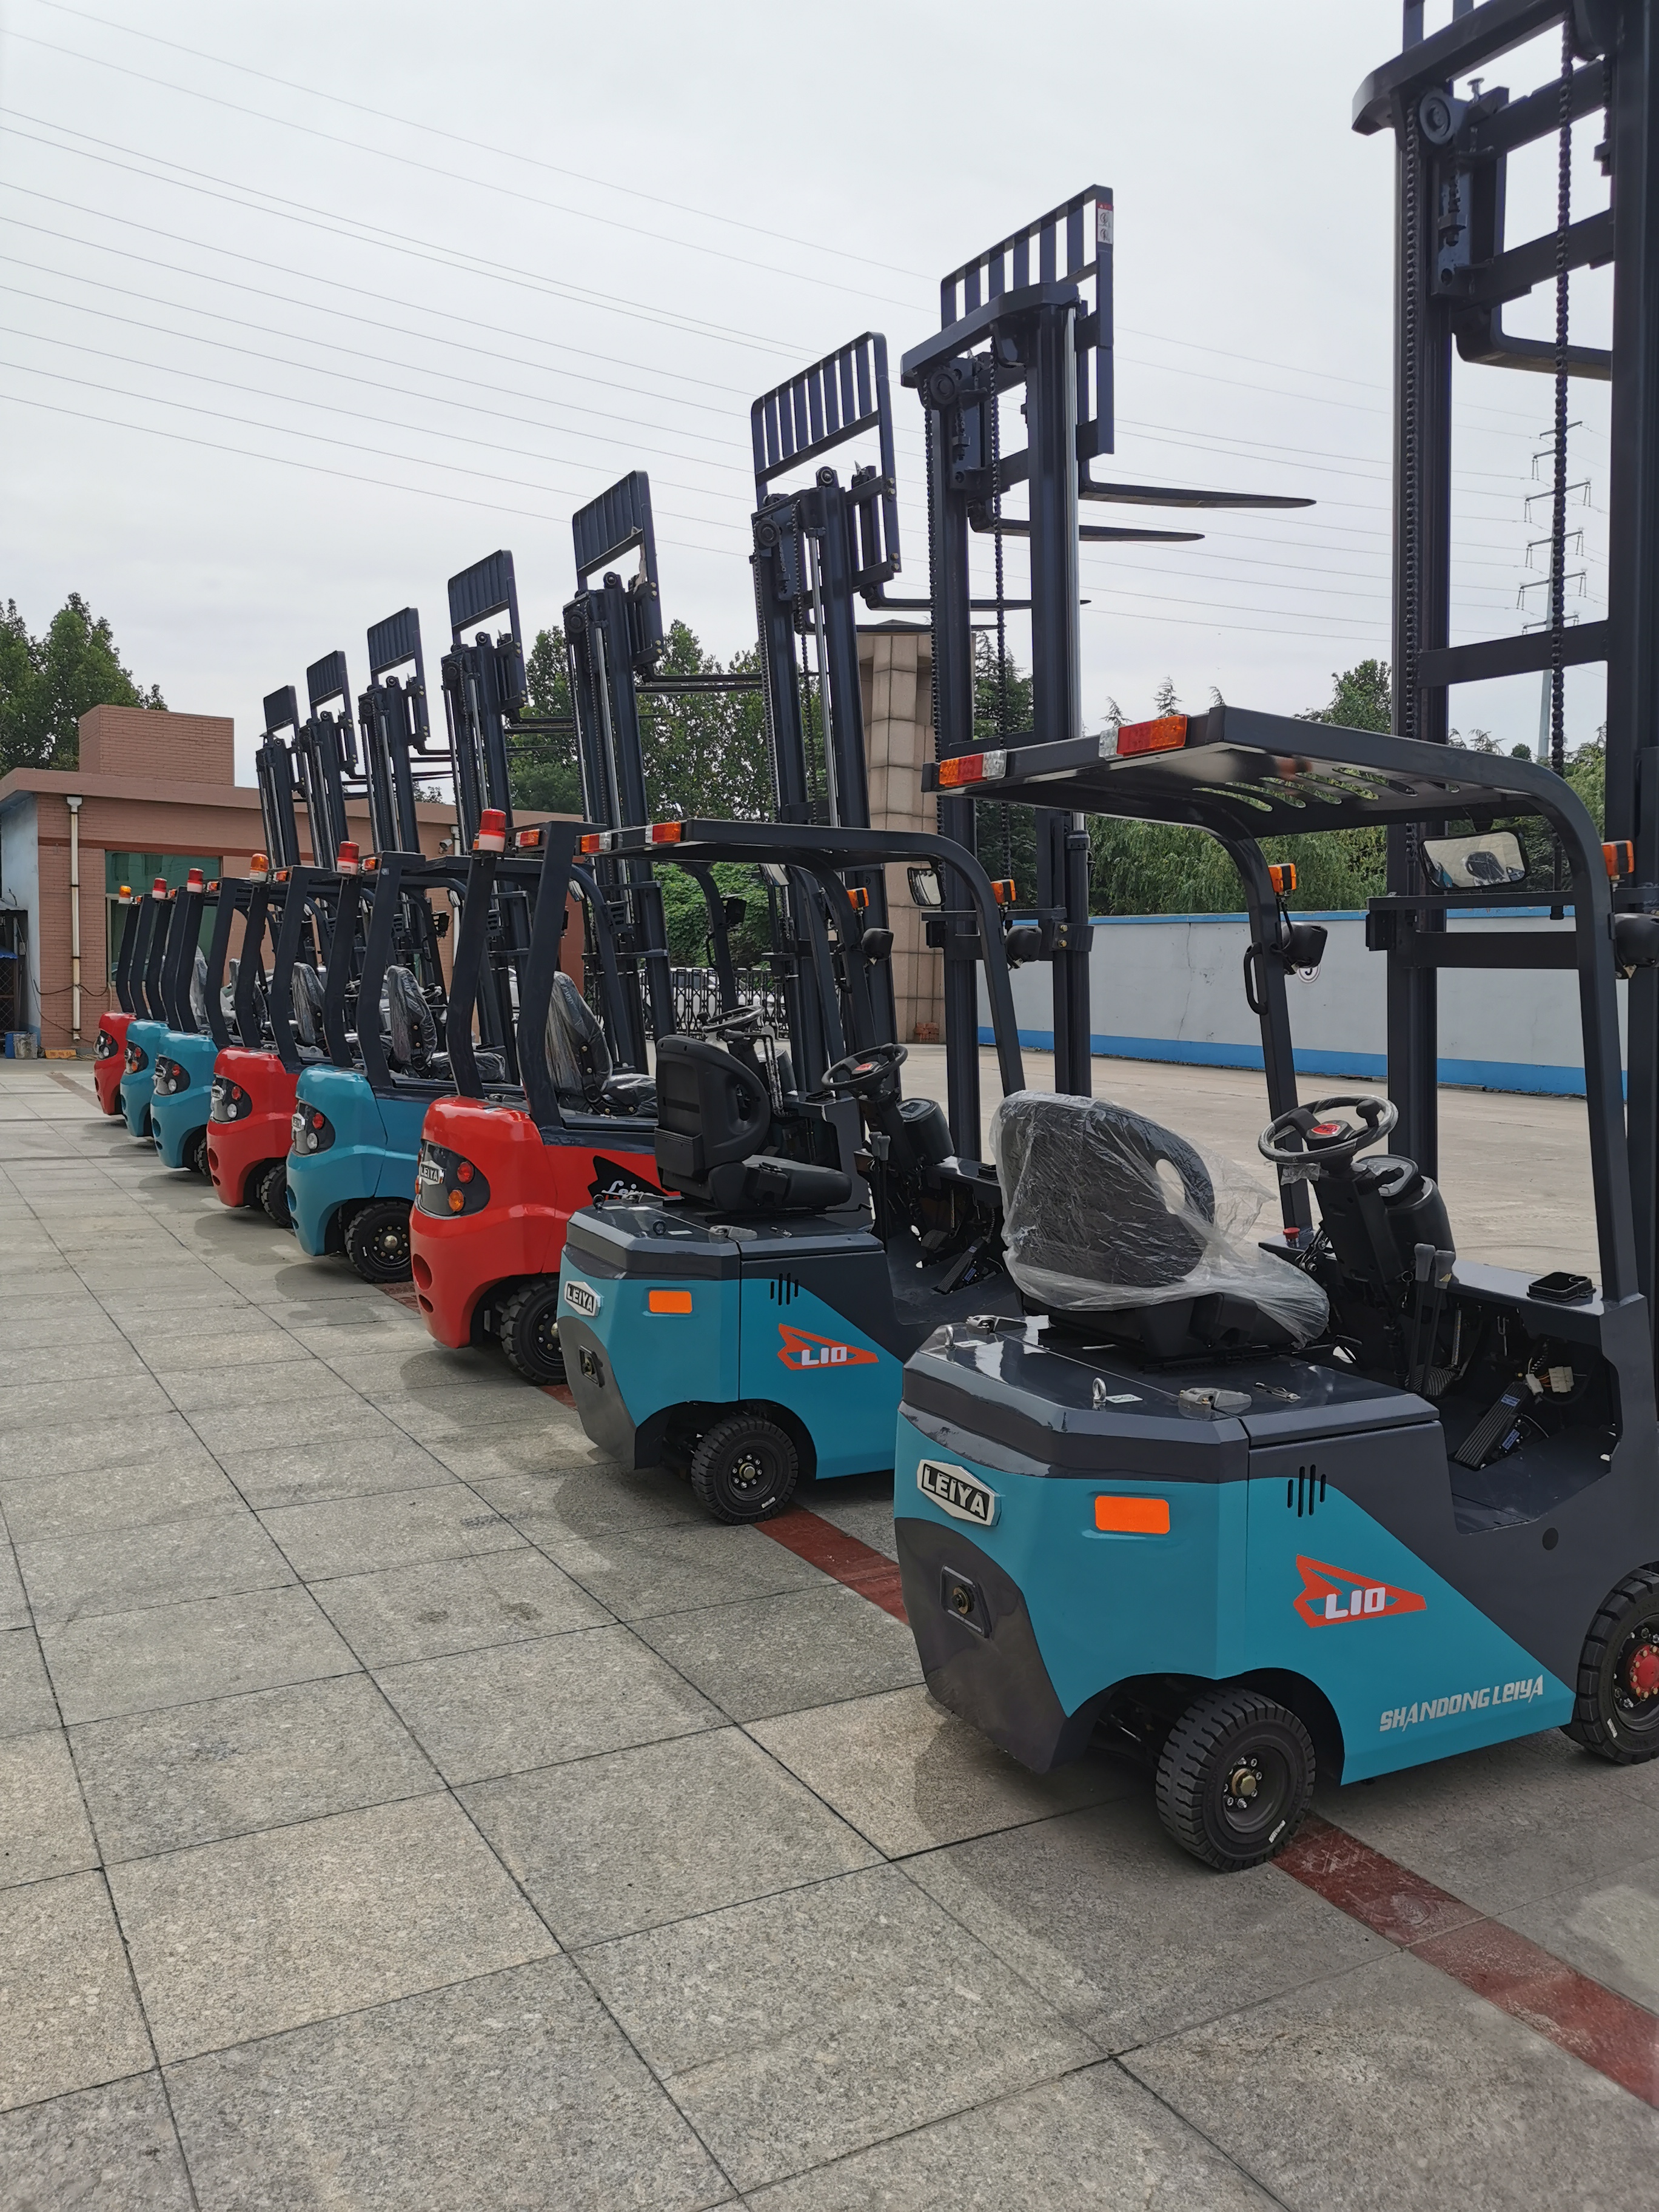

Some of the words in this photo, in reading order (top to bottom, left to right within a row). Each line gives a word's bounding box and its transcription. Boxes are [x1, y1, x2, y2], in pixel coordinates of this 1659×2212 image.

[420, 1165, 438, 1181] LEIYA
[567, 1285, 593, 1312] LEIYA
[923, 1466, 986, 1518] LEIYA
[1379, 1687, 1490, 1732] SHANDONG
